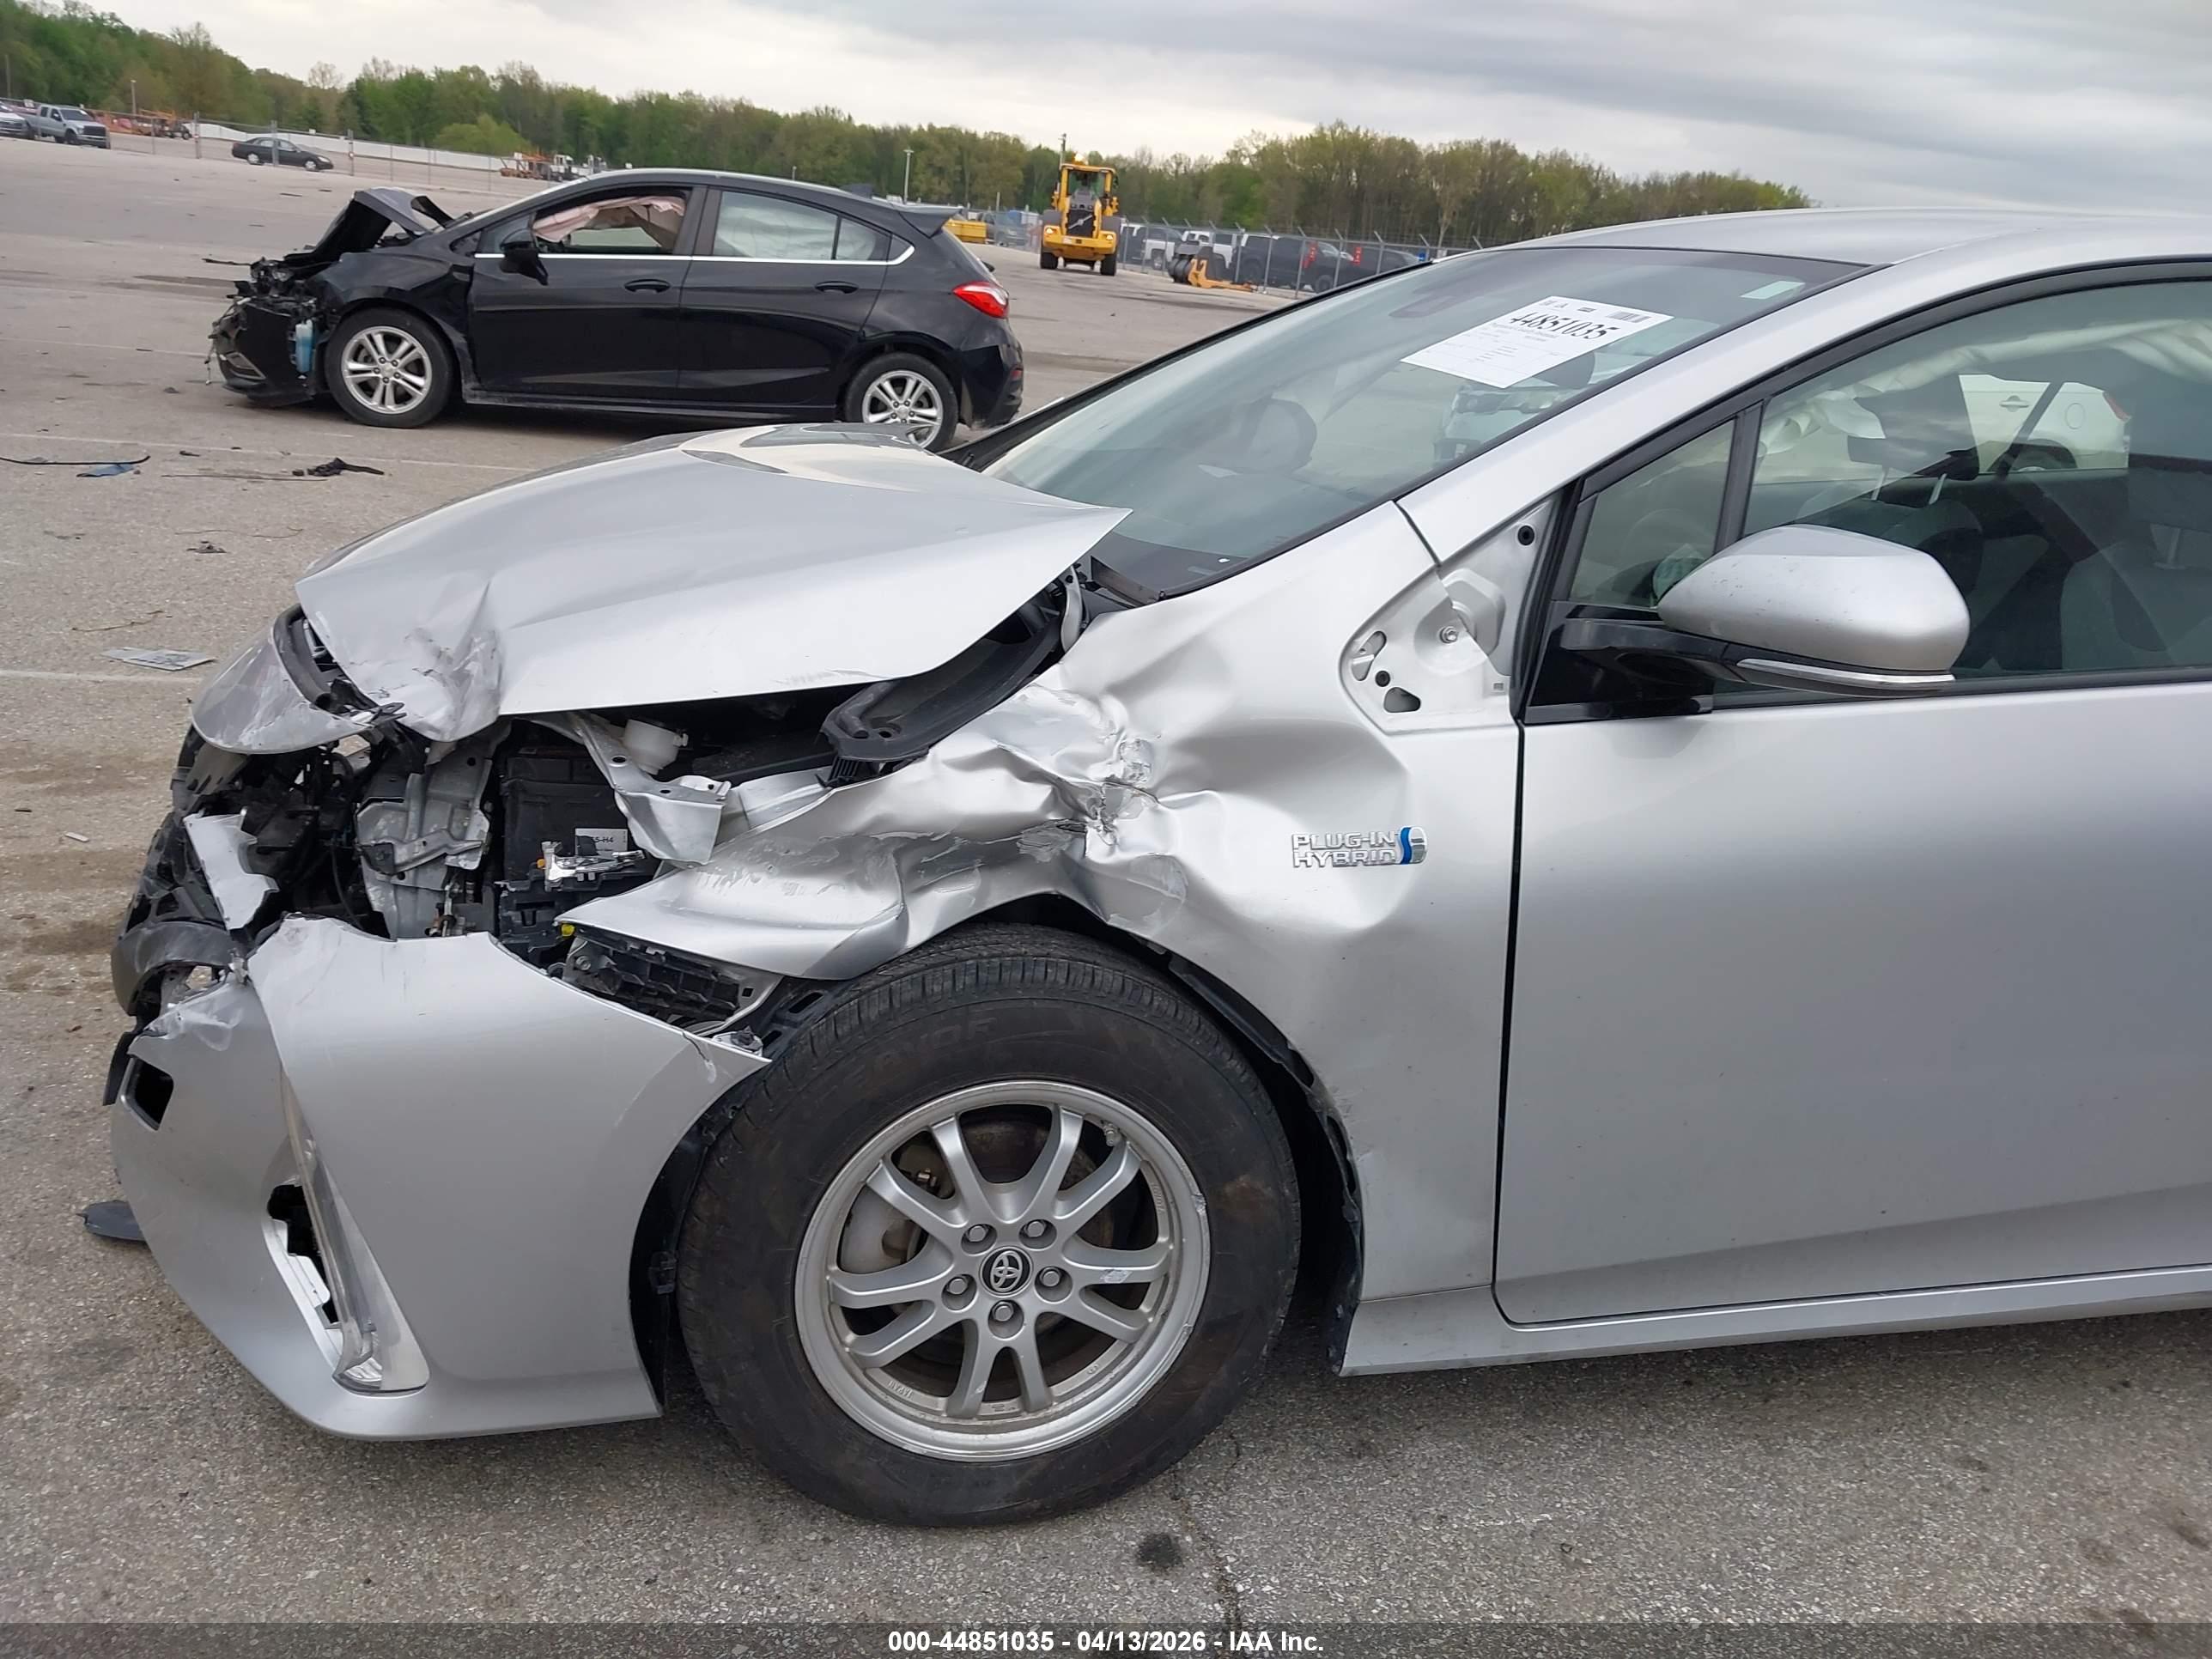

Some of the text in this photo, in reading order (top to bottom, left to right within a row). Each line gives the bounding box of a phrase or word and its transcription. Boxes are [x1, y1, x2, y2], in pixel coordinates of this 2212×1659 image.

[1510, 312, 1620, 339] 44851035
[1291, 831, 1395, 850] PLUG-IN
[1293, 849, 1397, 868] HYBRID
